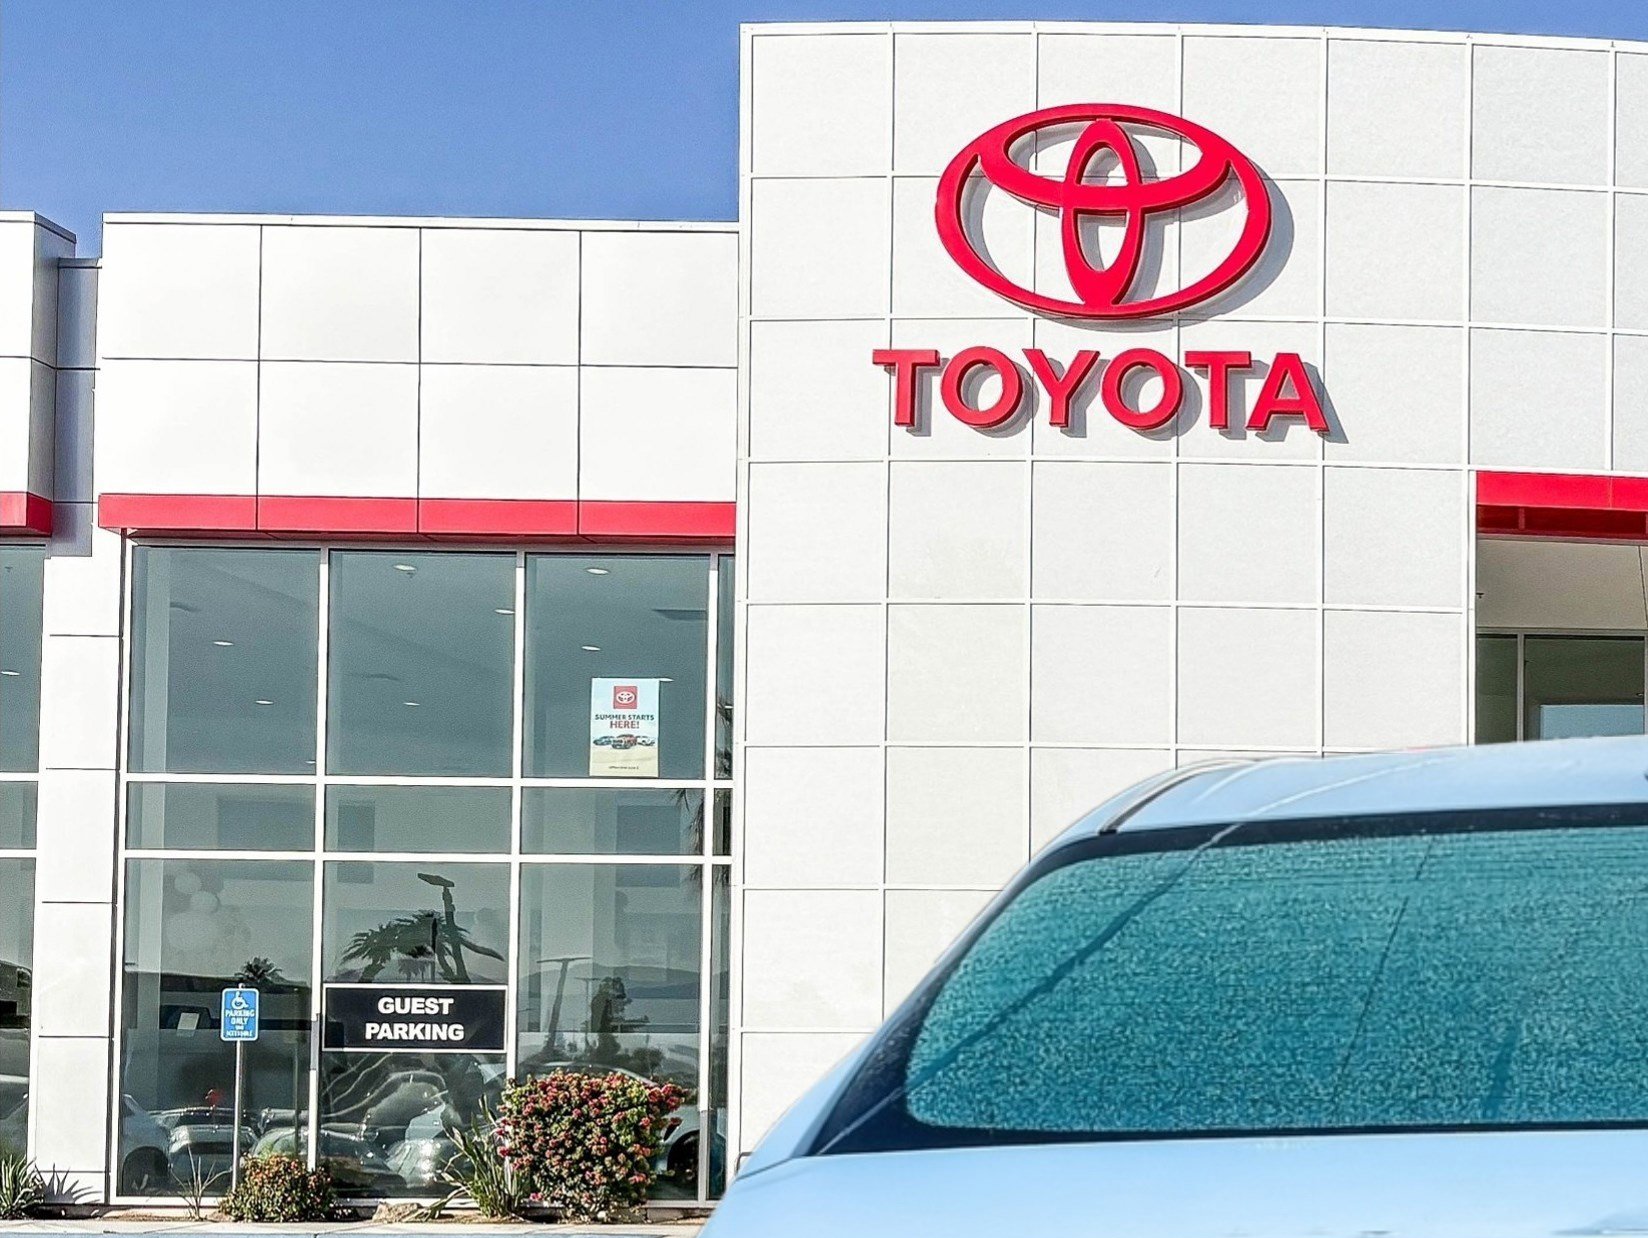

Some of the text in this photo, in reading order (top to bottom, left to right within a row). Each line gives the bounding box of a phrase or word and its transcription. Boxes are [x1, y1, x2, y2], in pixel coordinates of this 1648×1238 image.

[872, 346, 1330, 433] TOYOTA
[609, 720, 641, 729] HERE!
[377, 996, 455, 1015] GUEST
[231, 1017, 249, 1025] ONLY
[364, 1022, 465, 1041] PARKING
